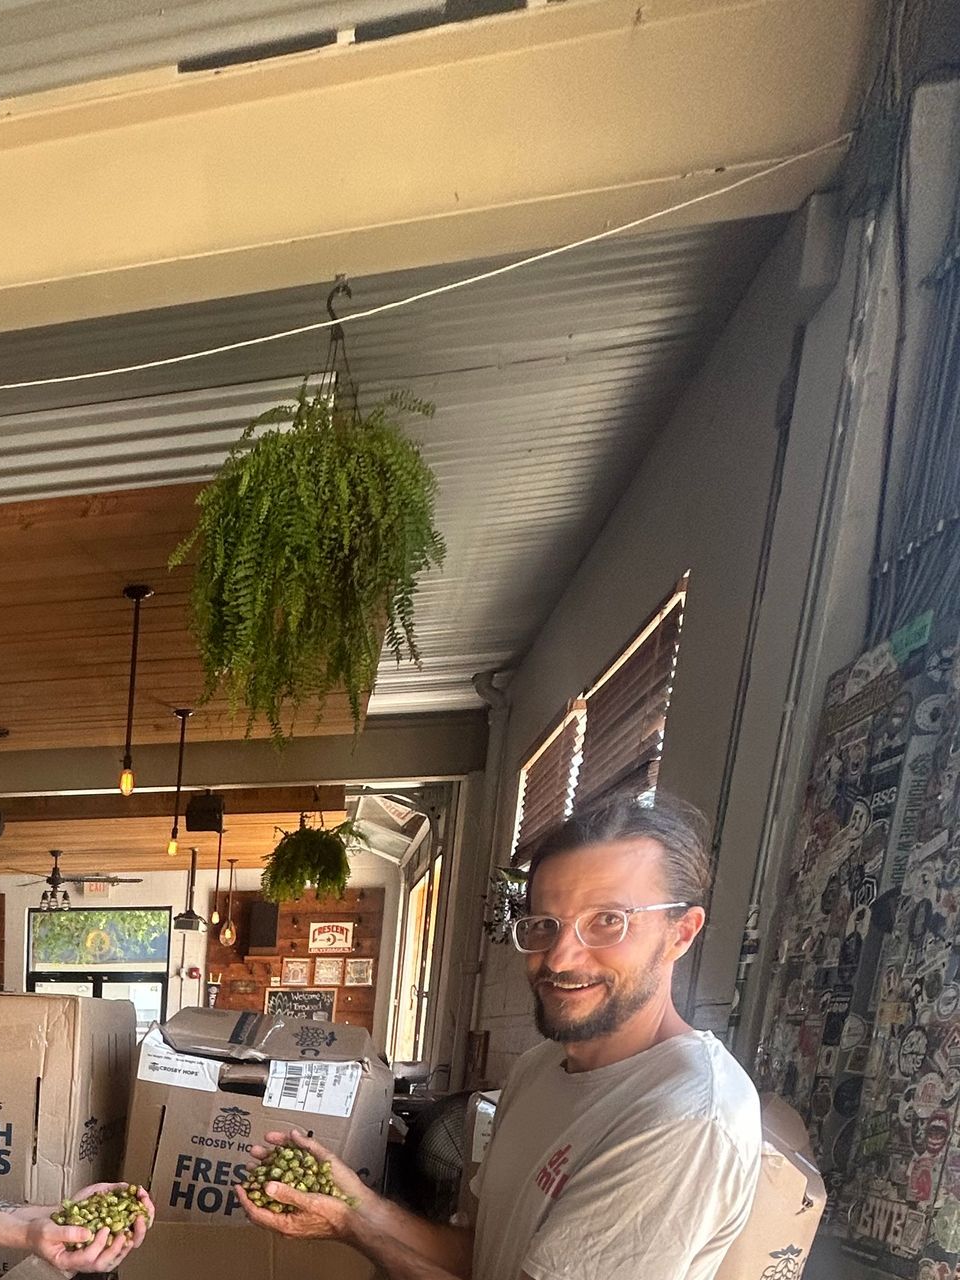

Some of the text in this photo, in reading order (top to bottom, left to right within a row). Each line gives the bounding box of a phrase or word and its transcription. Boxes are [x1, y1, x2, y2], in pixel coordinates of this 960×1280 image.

[312, 925, 349, 943] CRESCENT
[291, 992, 321, 1001] Welcome
[159, 1065, 181, 1074] CROSBY
[191, 1135, 253, 1153] CROSBY HO
[175, 1154, 247, 1187] FRES
[169, 1180, 242, 1216] HOP
